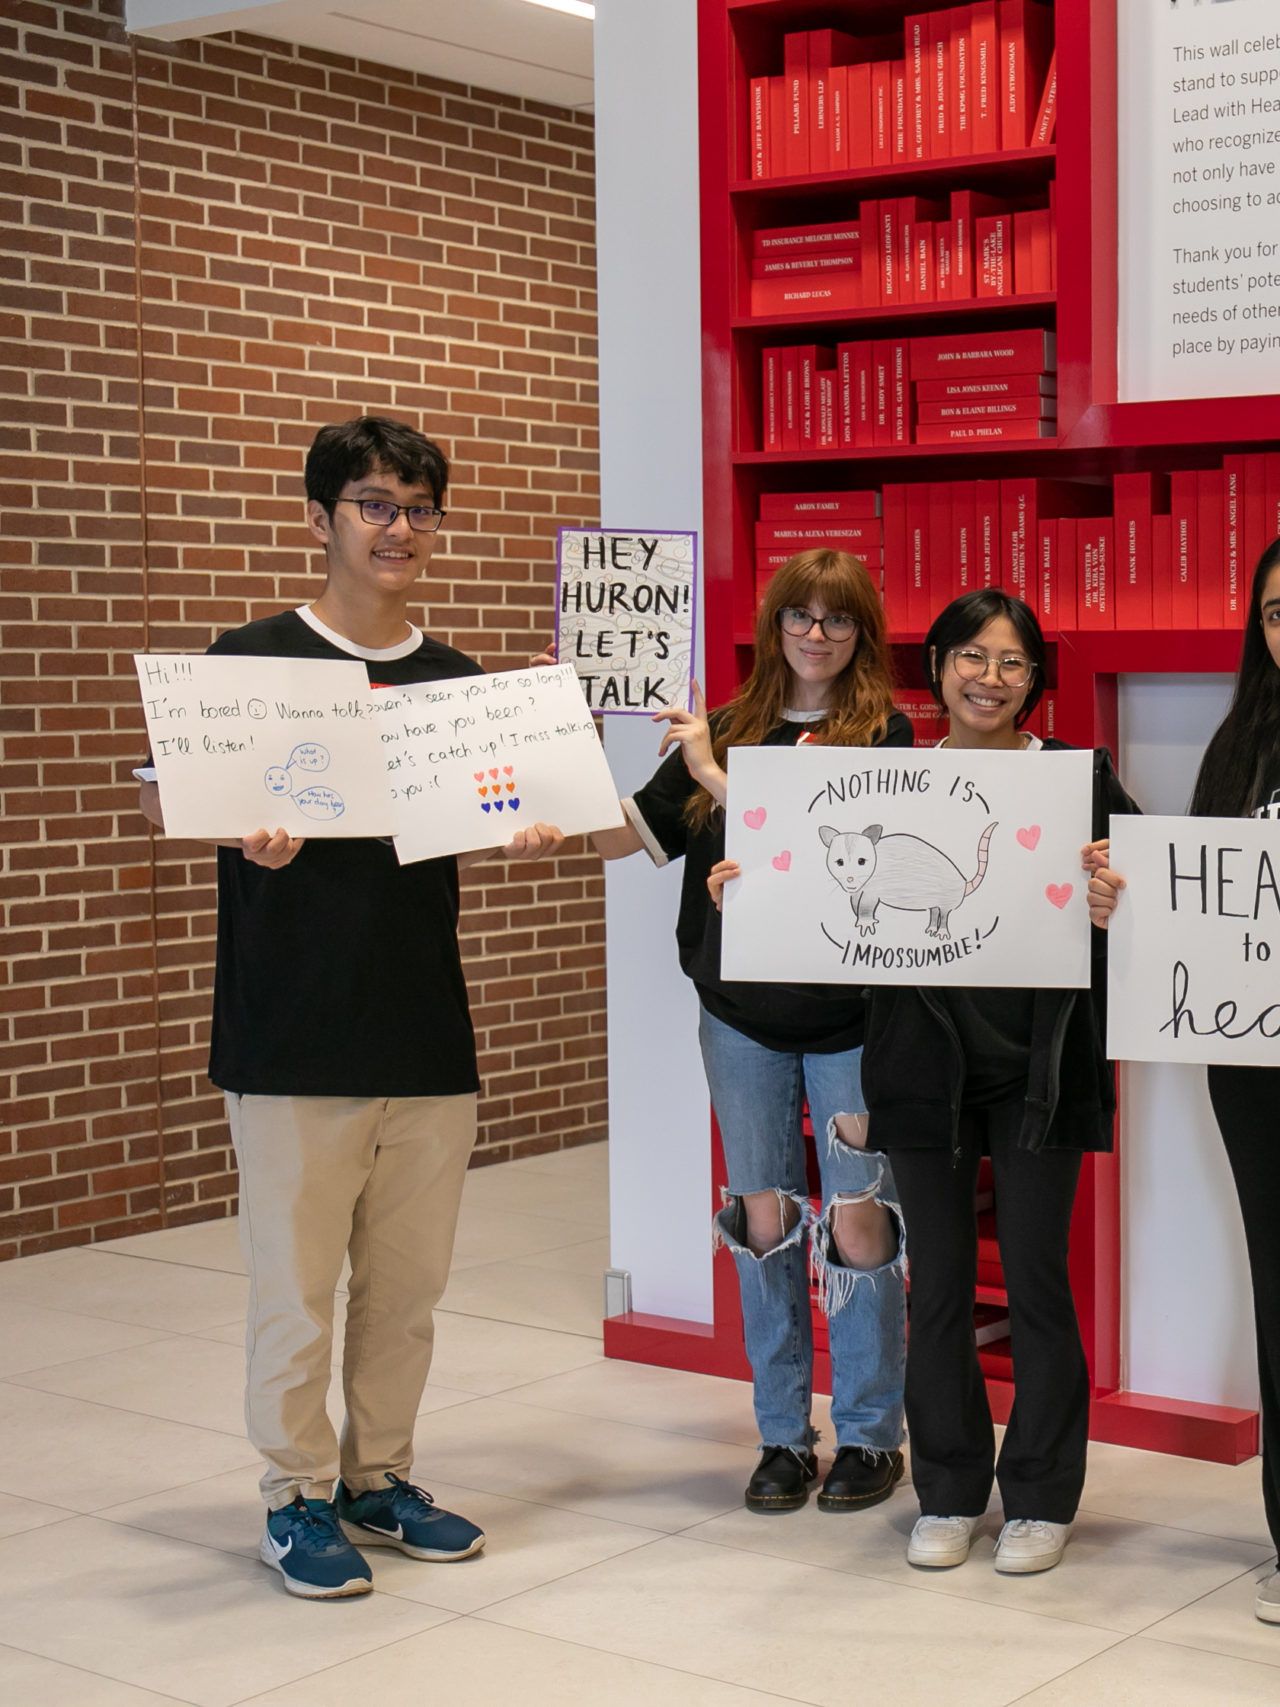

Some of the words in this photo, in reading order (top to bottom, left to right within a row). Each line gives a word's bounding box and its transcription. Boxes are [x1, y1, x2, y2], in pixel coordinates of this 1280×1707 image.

[1173, 104, 1209, 124] Lead
[1213, 100, 1246, 118] with
[1172, 137, 1204, 153] who
[1173, 167, 1198, 184] not
[1202, 163, 1234, 183] only
[1239, 161, 1275, 177] have
[1173, 194, 1242, 214] choosing
[1246, 192, 1262, 207] to
[784, 291, 812, 300] RICHARD
[812, 290, 832, 298] LUCAS
[583, 536, 659, 571] HEY
[561, 581, 690, 615] HURON!
[576, 630, 670, 660] LET'S
[425, 692, 454, 704] seen
[460, 685, 487, 702] you
[491, 677, 509, 691] for
[516, 678, 532, 688] so
[578, 675, 670, 707] TALK
[147, 697, 187, 720] I'm
[200, 699, 241, 718] bored
[275, 702, 324, 719] Wanna
[404, 723, 438, 737] have
[448, 716, 476, 737] you
[157, 737, 190, 756] I'll
[203, 735, 255, 755] listen!
[428, 742, 472, 764] catch
[524, 727, 551, 744] miss
[555, 721, 595, 739] talking
[401, 784, 423, 801] you
[826, 768, 931, 806] NOTHING
[950, 775, 975, 803] IS
[841, 927, 983, 969] IMPOSSUMBLE!
[1242, 932, 1271, 963] to
